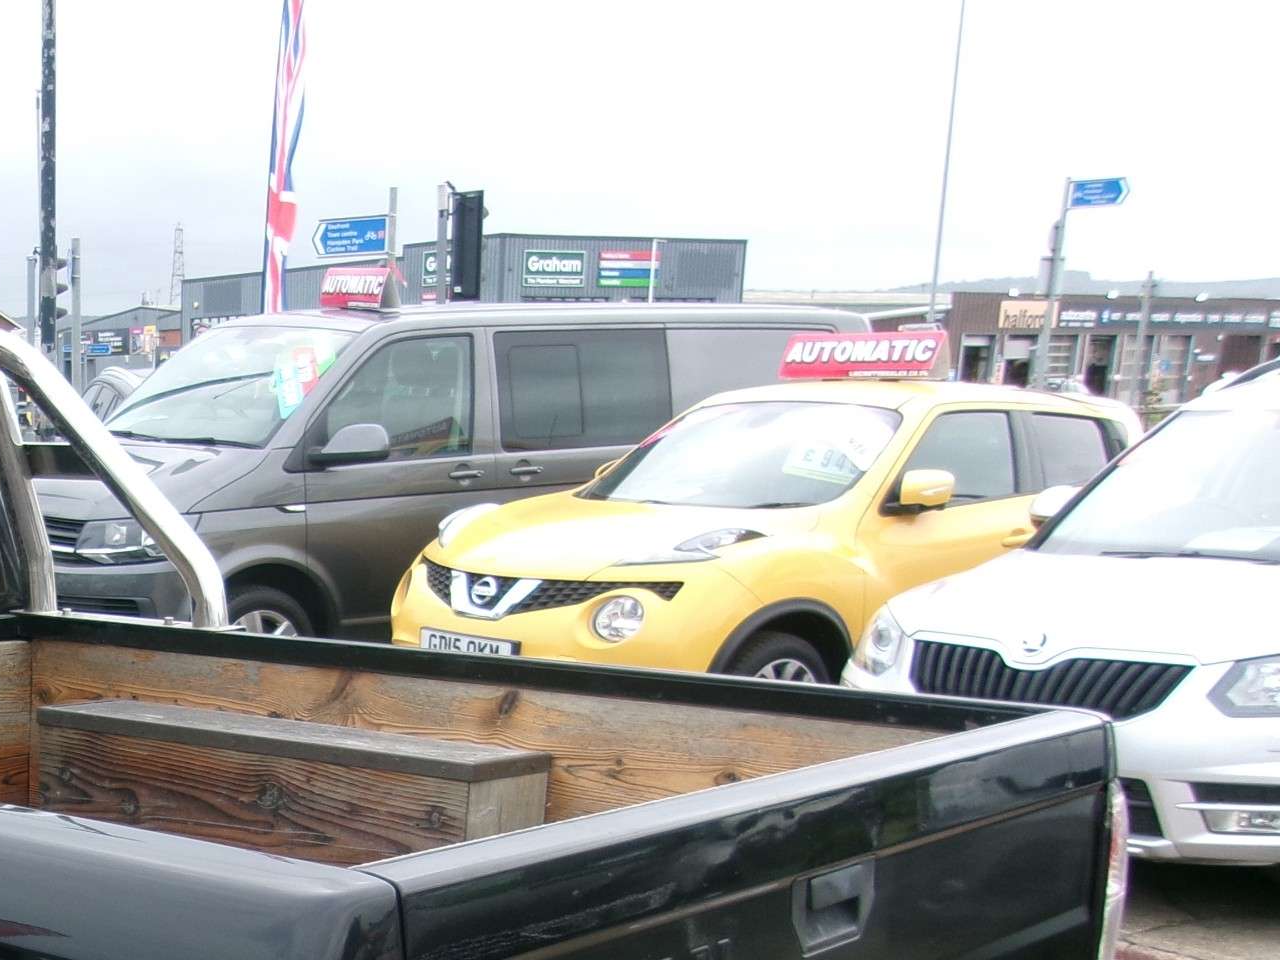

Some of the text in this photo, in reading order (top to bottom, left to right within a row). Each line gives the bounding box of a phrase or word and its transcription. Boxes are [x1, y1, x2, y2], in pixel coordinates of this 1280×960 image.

[528, 256, 582, 273] Graham
[322, 275, 384, 295] AUTOMATIC
[785, 339, 937, 363] AUTOMATIC
